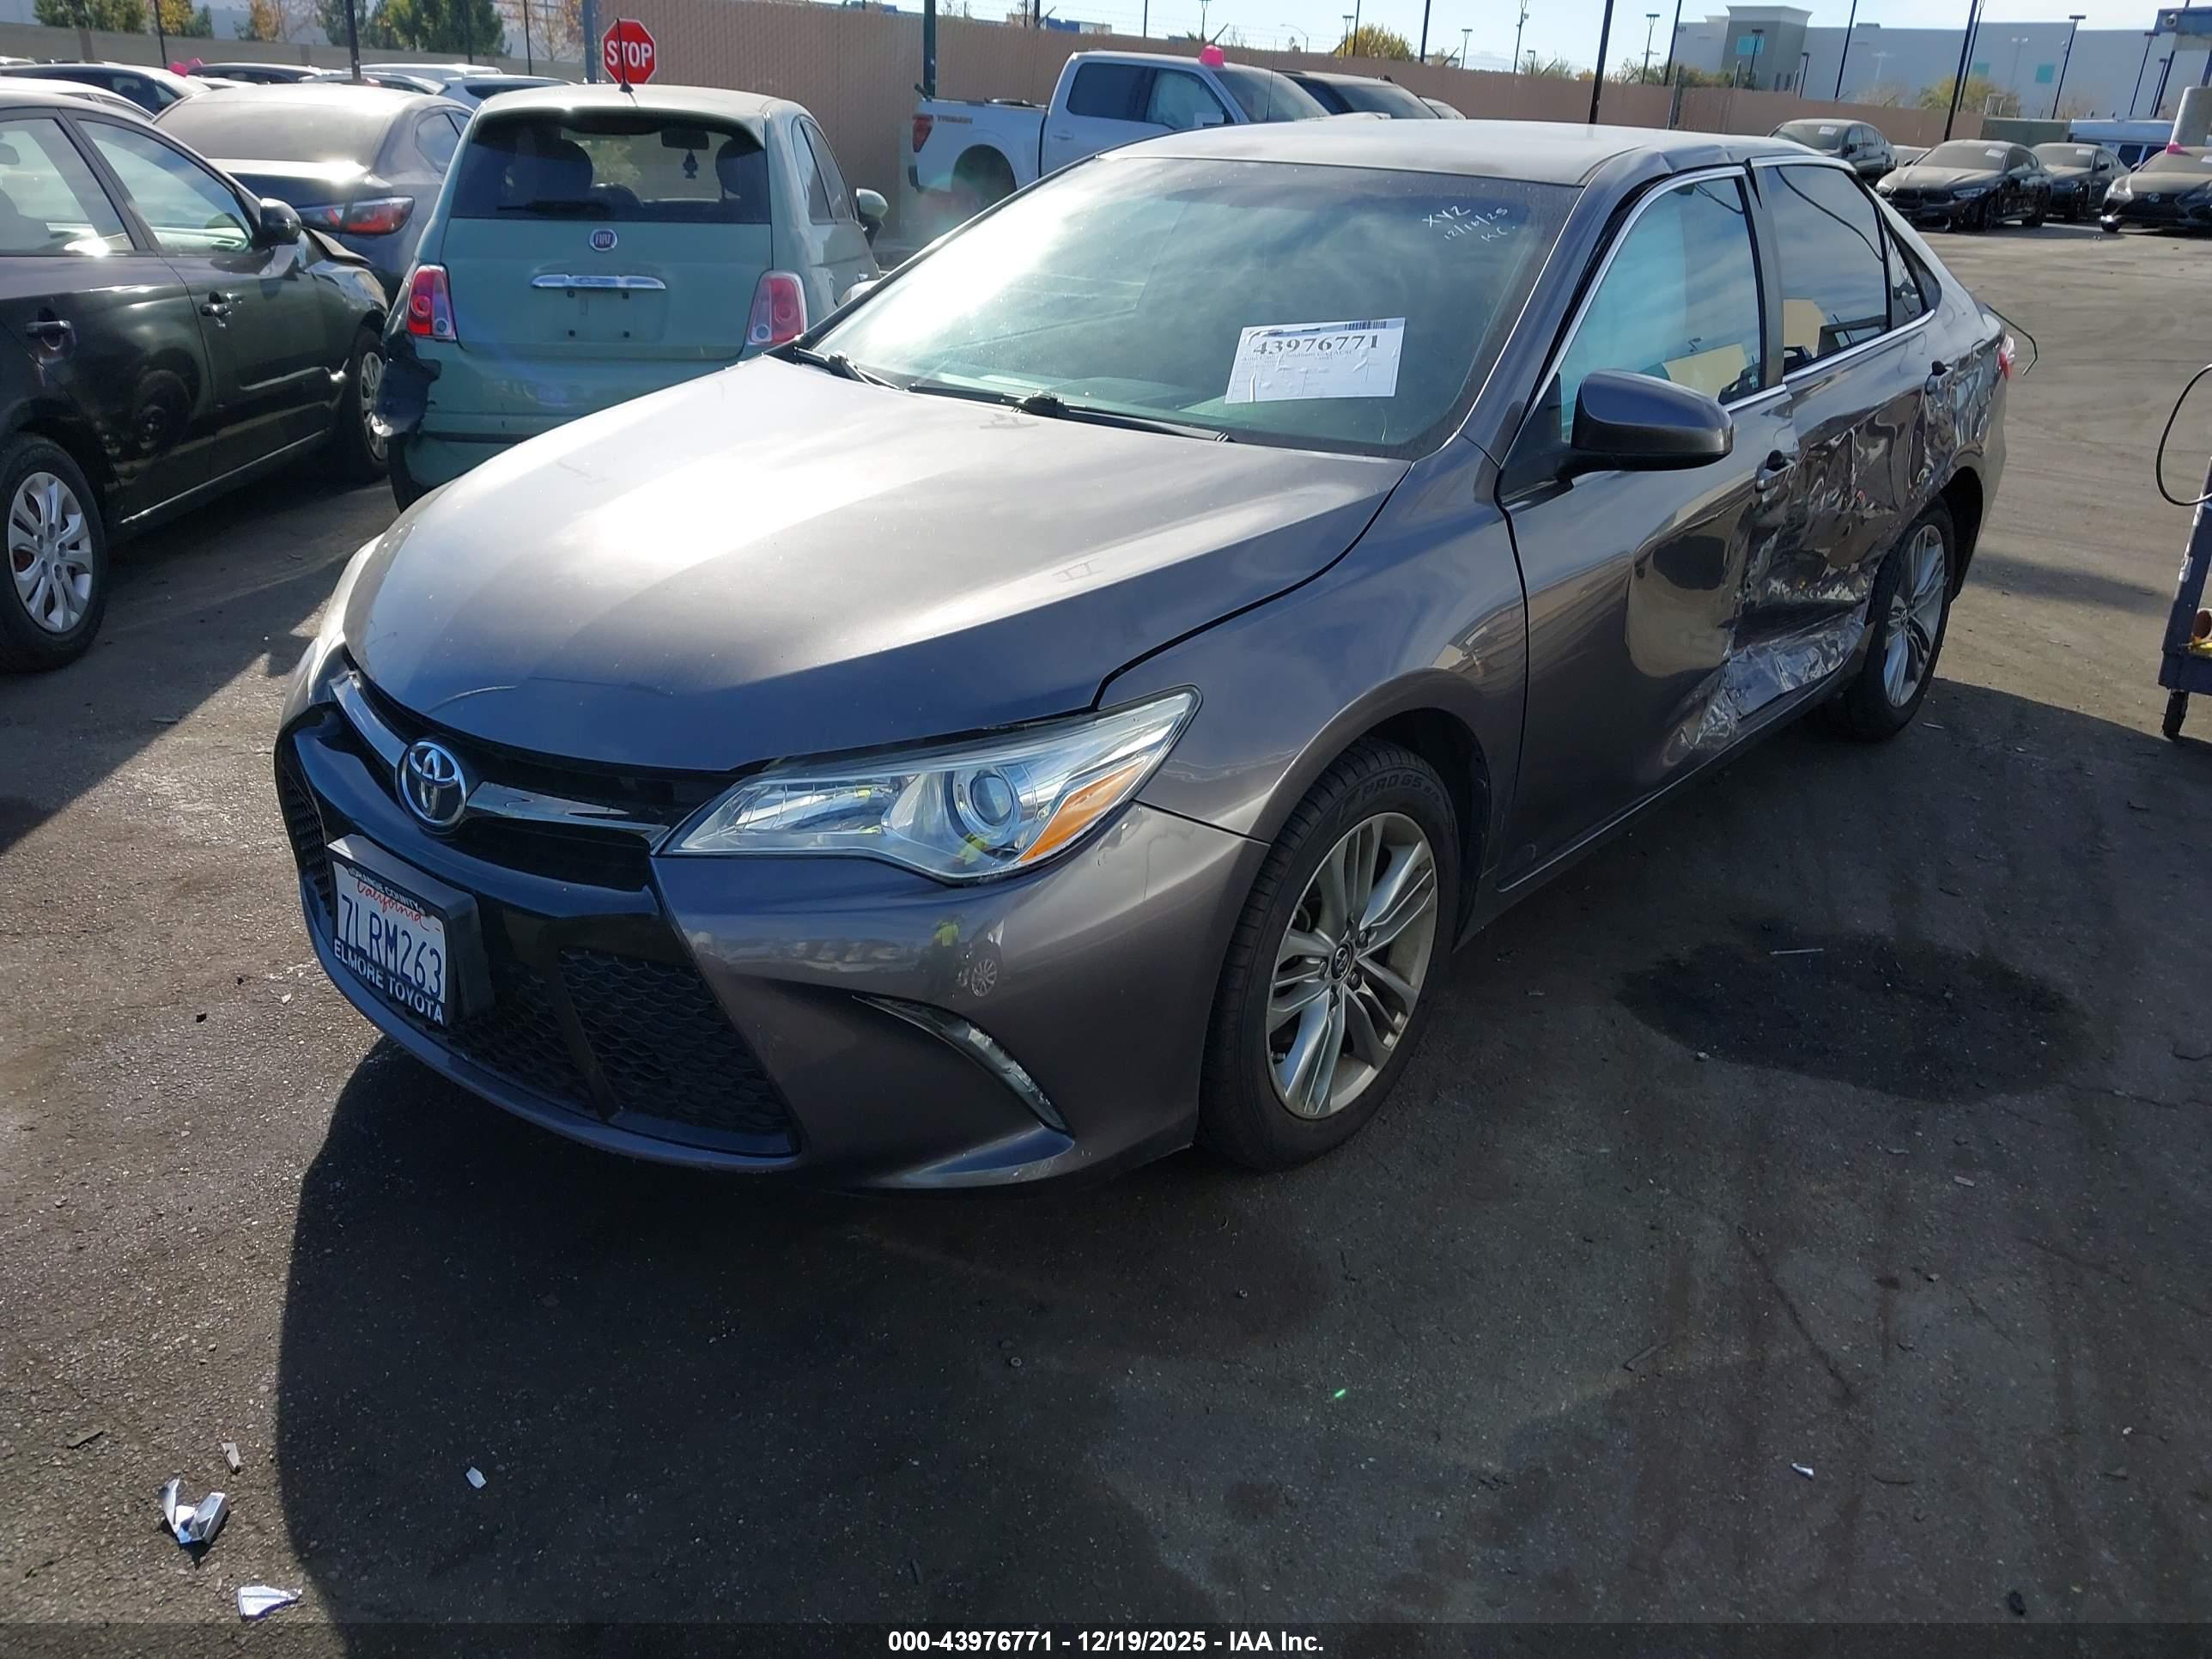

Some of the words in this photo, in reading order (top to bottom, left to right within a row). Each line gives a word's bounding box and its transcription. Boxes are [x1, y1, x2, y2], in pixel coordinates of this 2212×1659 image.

[606, 40, 653, 68] STOP
[1253, 334, 1379, 355] 43976771
[384, 886, 419, 912] COUNTY
[342, 893, 442, 999] 7LRM263
[334, 939, 385, 989] ELMORE
[389, 977, 444, 1025] TOYOTA
